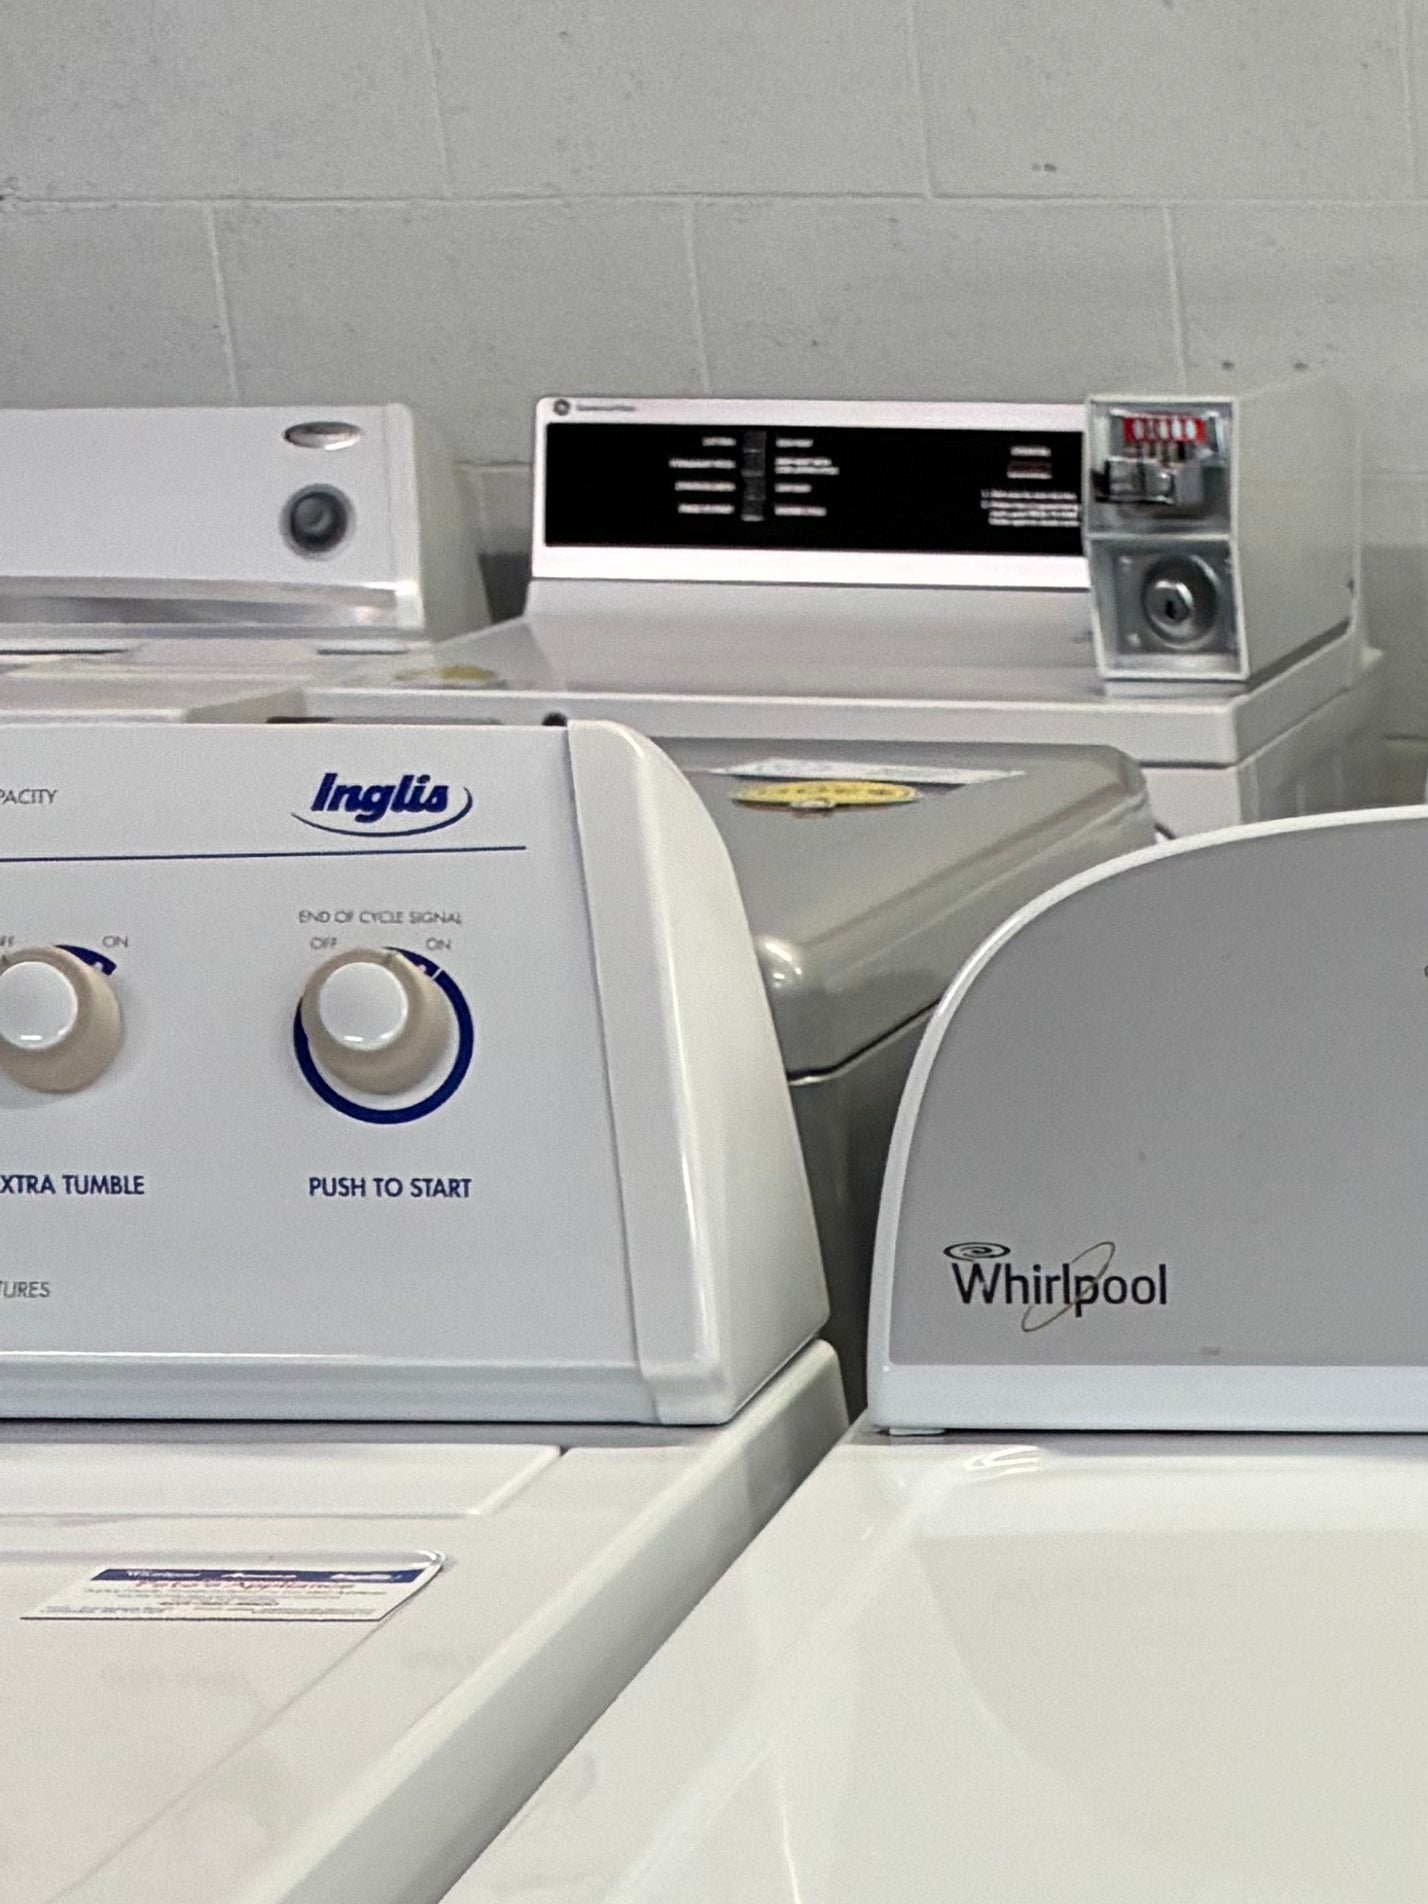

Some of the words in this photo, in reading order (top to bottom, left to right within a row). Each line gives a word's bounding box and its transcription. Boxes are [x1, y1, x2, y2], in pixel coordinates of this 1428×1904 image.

[310, 773, 449, 823] Inglis
[299, 910, 331, 923] END
[409, 910, 462, 926] SIGNAL
[310, 937, 337, 950] OFF
[425, 938, 452, 950] ON
[62, 1174, 145, 1195] TUMBLE
[309, 1177, 366, 1196] PUSH
[373, 1177, 403, 1197] TO
[410, 1177, 472, 1198] START
[0, 1280, 51, 1298] URES
[951, 1262, 1167, 1318] Whirlpool
